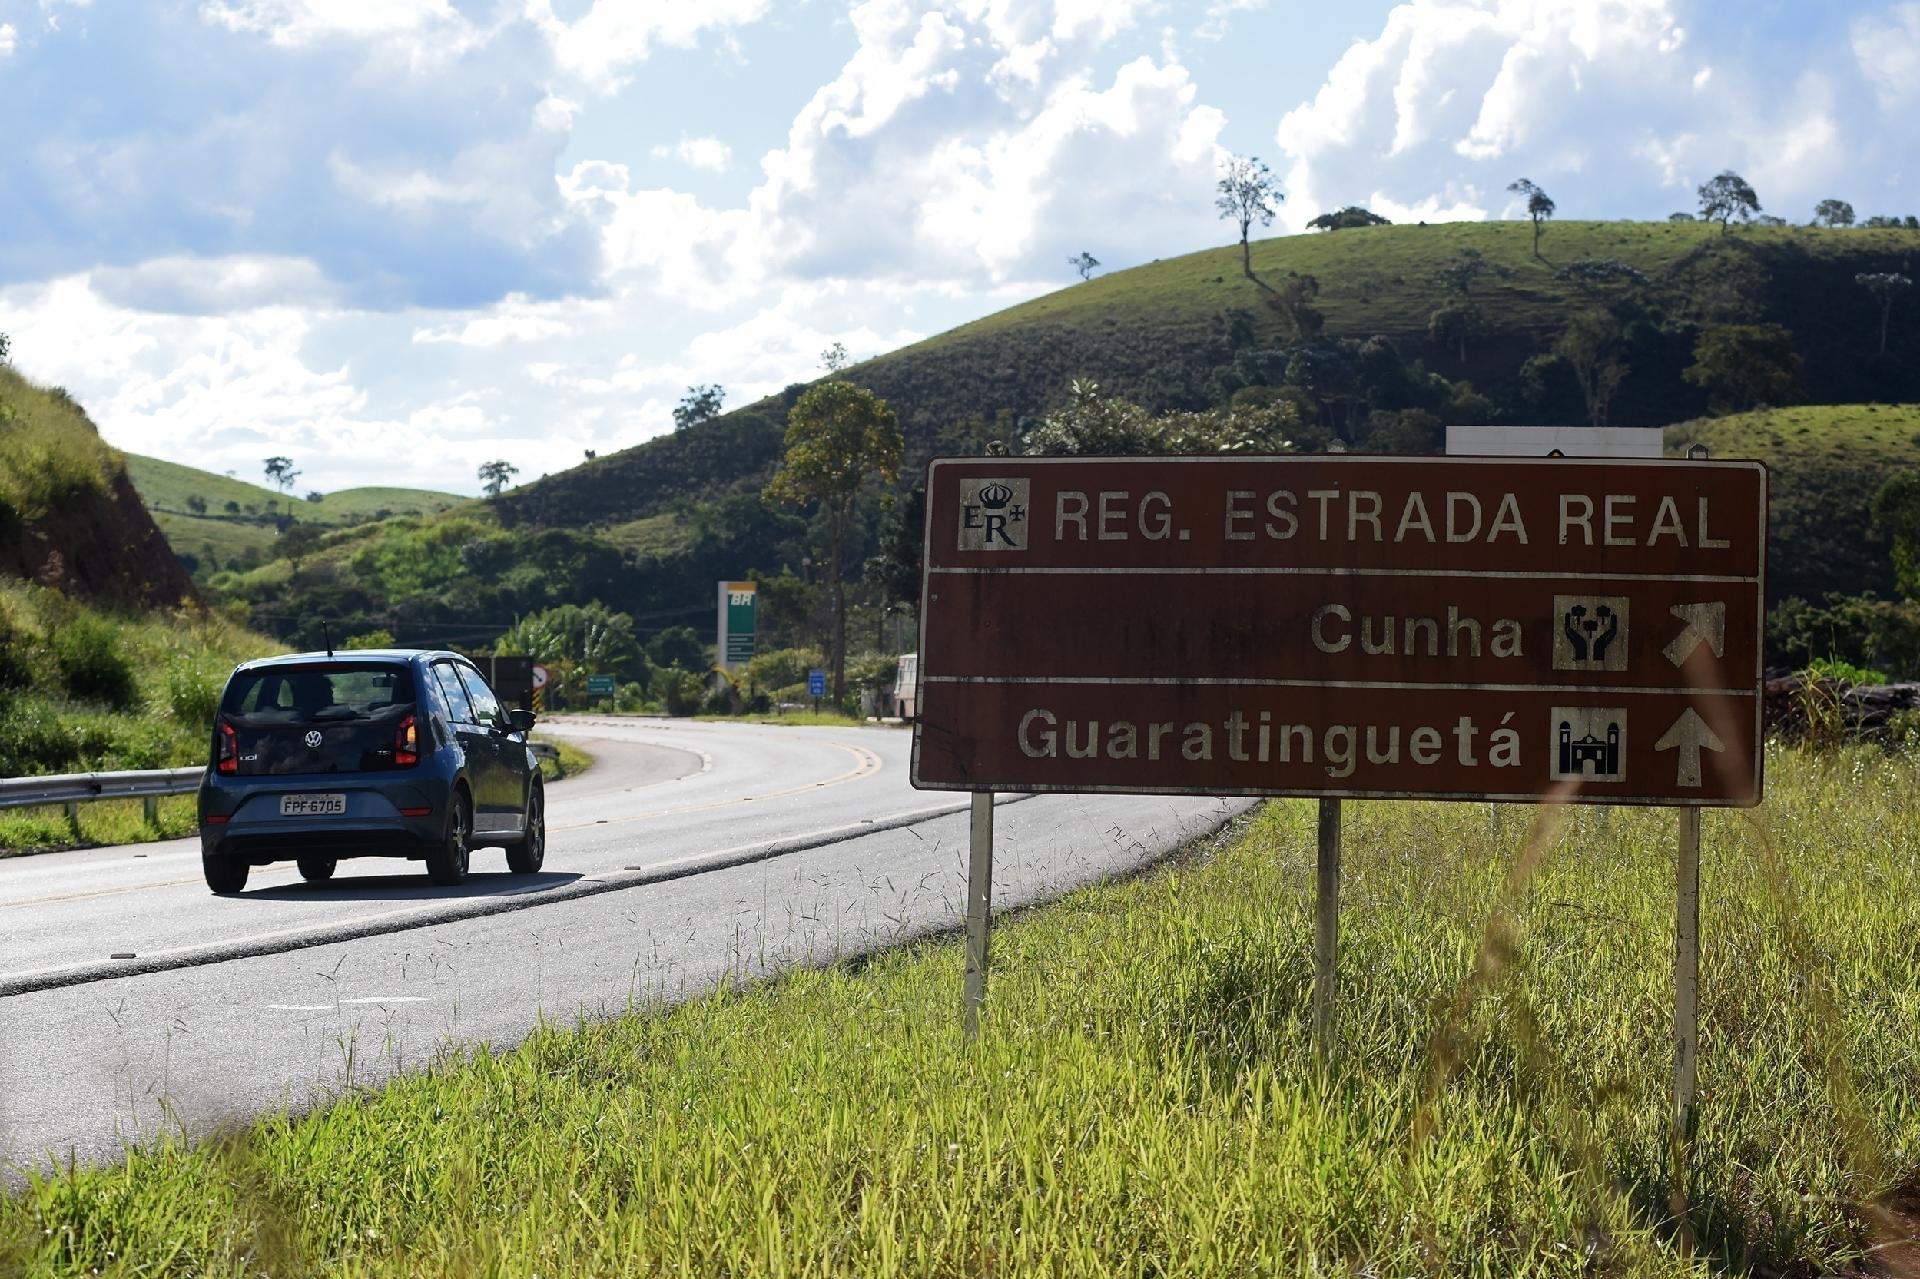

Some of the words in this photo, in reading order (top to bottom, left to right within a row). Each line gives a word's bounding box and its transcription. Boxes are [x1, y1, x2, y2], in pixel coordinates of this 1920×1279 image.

[1054, 491, 1191, 541] REG.
[1224, 490, 1530, 546] ESTRADA
[1557, 493, 1732, 550] REAL
[1310, 602, 1525, 658] Cunha
[1017, 708, 1523, 778] Guaratinguetá
